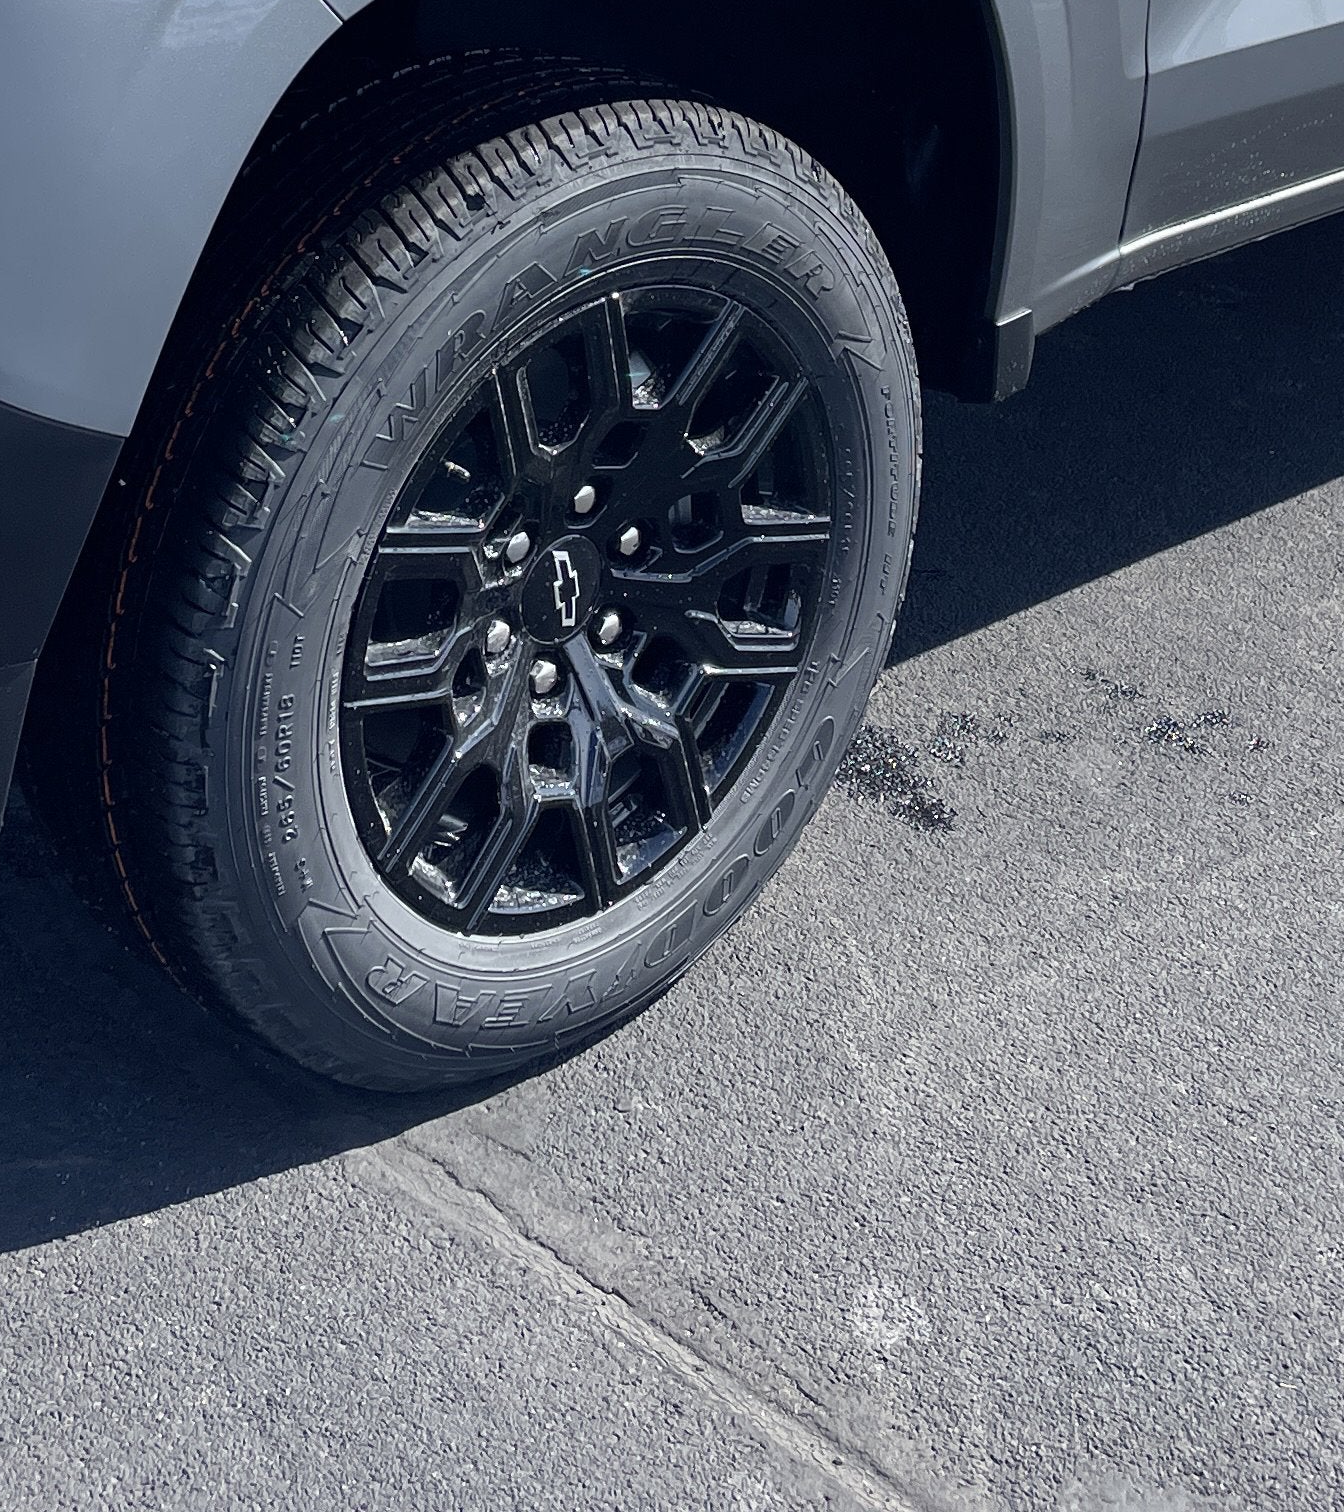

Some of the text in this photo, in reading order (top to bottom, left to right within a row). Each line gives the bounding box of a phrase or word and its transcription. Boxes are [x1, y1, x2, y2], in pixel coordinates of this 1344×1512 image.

[360, 205, 837, 471] WRANGLER
[274, 692, 300, 847] 265/60R18
[365, 715, 836, 1028] GOODYEAR
